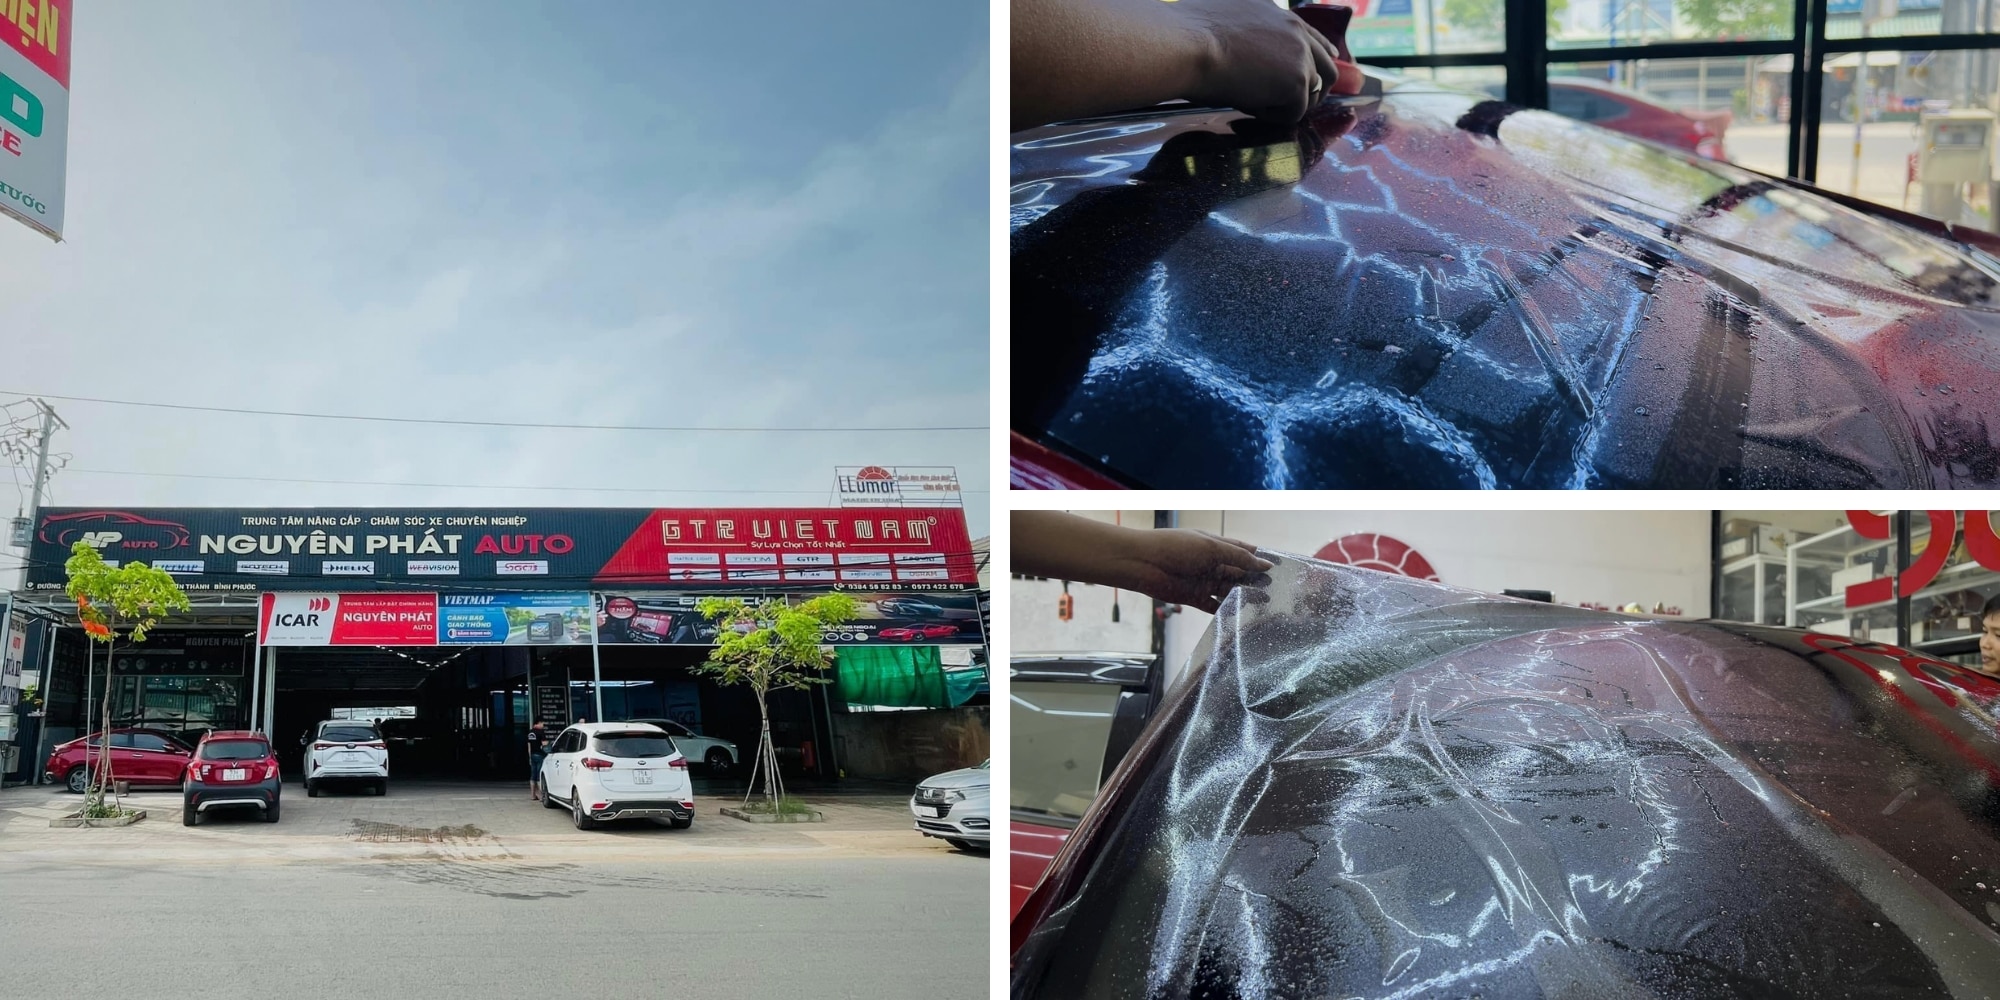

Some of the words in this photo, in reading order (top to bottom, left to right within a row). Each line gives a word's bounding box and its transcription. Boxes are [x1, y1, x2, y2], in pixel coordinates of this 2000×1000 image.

[242, 517, 277, 526] TRUNG
[280, 515, 303, 526] TÂM
[307, 515, 336, 526] NÂNG
[340, 514, 361, 526] CẤP
[370, 516, 400, 526] CHĂM
[404, 516, 425, 526] SÓC
[429, 517, 442, 526] XE
[446, 516, 487, 526] CHUYÊN
[491, 515, 527, 527] NGHIỆP
[662, 520, 735, 540] GTR
[122, 540, 158, 549] AUTO
[199, 529, 354, 554] NGUYÊN
[366, 528, 462, 554] PHÁT
[474, 534, 574, 555] AUTO
[444, 596, 494, 605] VIETMAP
[275, 614, 319, 627] ICAR
[343, 611, 396, 622] NGUYÊN
[400, 611, 432, 622] PHÁT
